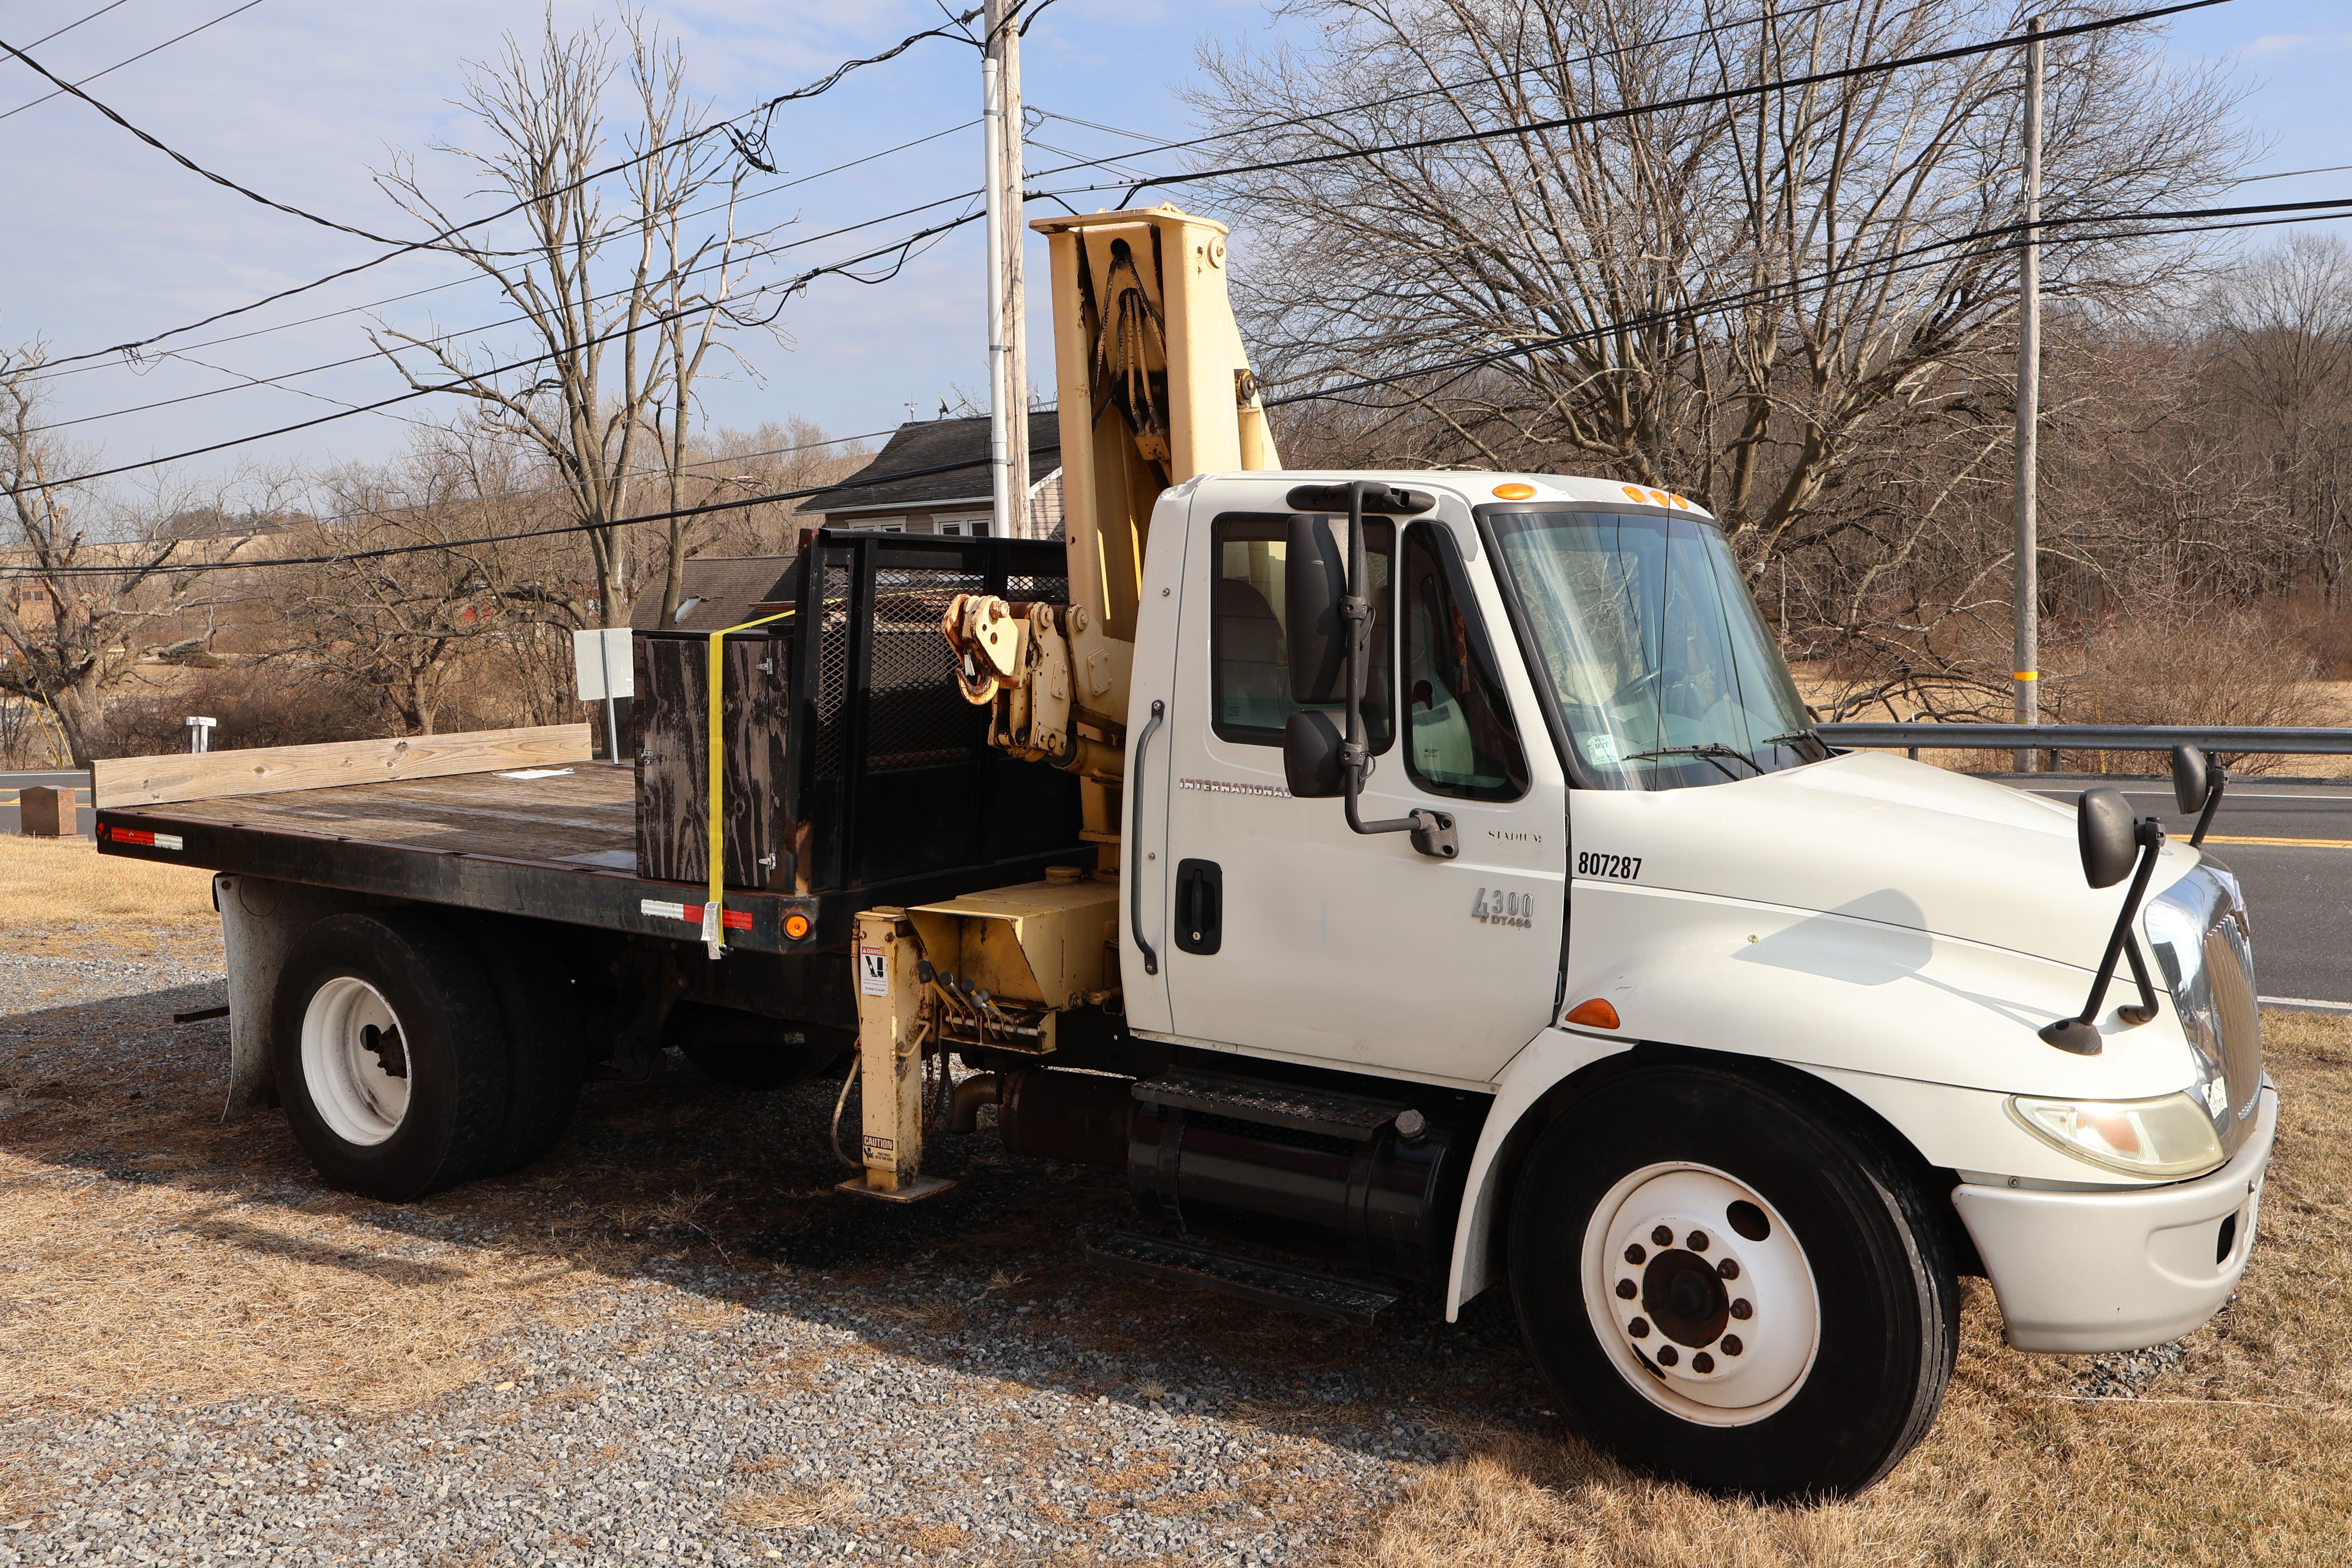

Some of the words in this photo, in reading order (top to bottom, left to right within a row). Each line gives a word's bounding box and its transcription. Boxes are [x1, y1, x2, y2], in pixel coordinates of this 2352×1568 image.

[1179, 778, 1292, 799] INTERNATIONAL
[1578, 851, 1642, 880] 807287
[1472, 887, 1534, 923] 4300
[1491, 915, 1532, 928] DT466
[864, 1136, 892, 1149] CAUTION
